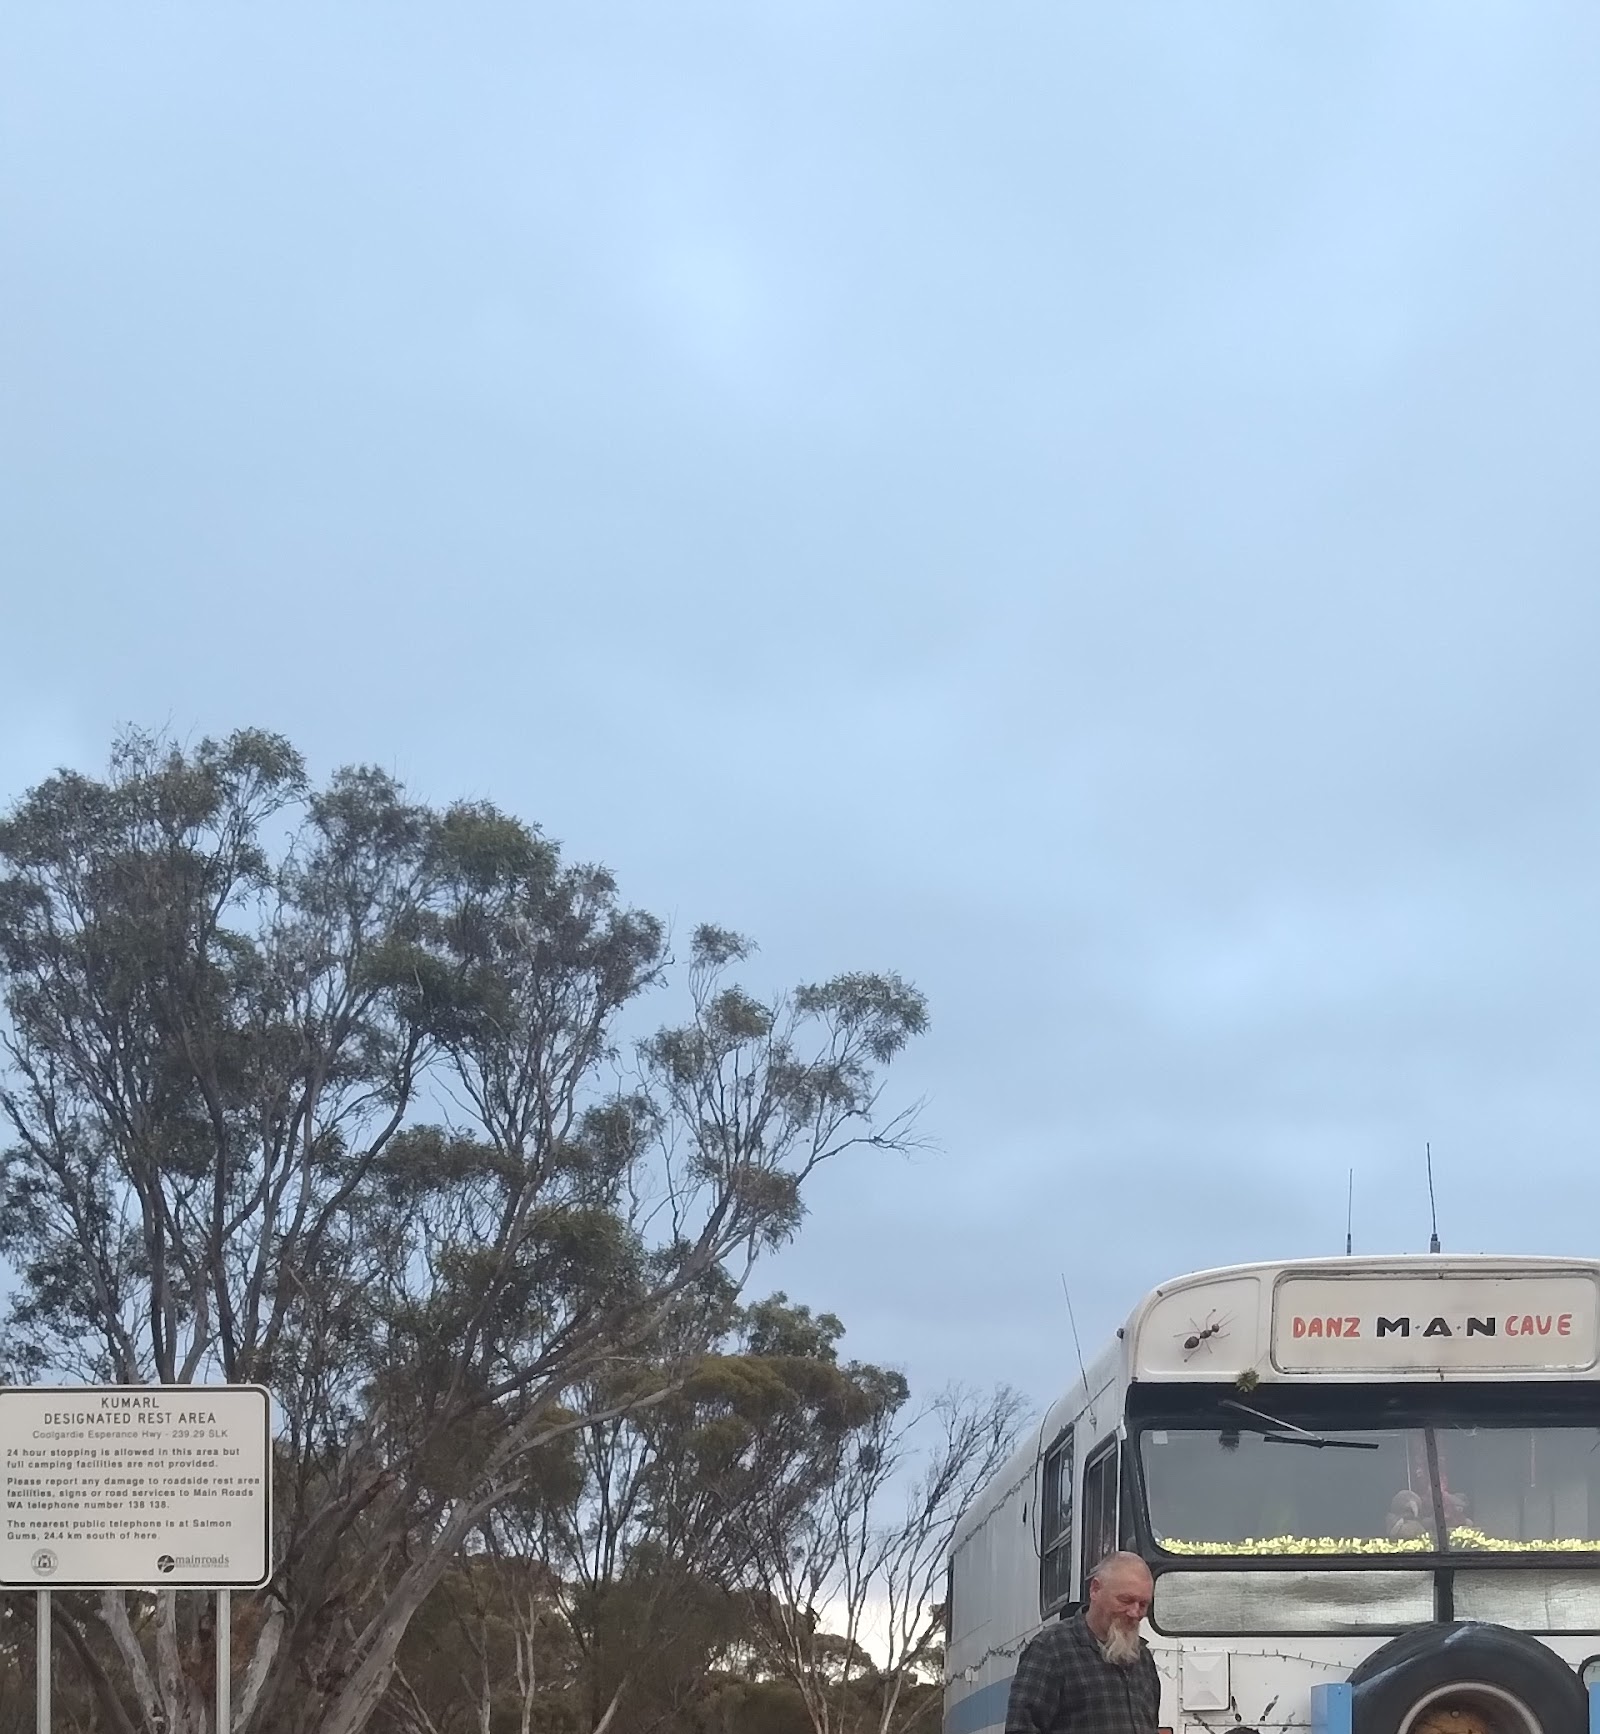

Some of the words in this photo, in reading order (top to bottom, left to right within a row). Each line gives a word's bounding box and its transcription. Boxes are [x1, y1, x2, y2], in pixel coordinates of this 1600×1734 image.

[1293, 1317, 1361, 1338] DANZ
[1505, 1314, 1573, 1336] CAVE
[101, 1397, 160, 1408] KUMARL
[44, 1413, 130, 1424] DESIGNATED
[138, 1412, 172, 1424] REST
[178, 1412, 216, 1424] AREA
[32, 1430, 84, 1440] Coolgardie
[88, 1430, 138, 1440] Esperance
[142, 1430, 162, 1440] Hwy
[209, 1429, 228, 1438] SLK
[51, 1448, 96, 1458] stopping
[101, 1448, 110, 1456] is
[114, 1448, 154, 1456] allowed
[158, 1448, 168, 1456] in
[28, 1460, 72, 1470] camping
[77, 1460, 123, 1468] facilities
[147, 1460, 164, 1468] not
[168, 1460, 218, 1469] provided.
[7, 1477, 41, 1485] Please
[46, 1478, 77, 1487] report
[82, 1479, 100, 1487] any
[104, 1477, 144, 1487] damage
[163, 1477, 208, 1485] roadside
[213, 1477, 233, 1485] rest
[7, 1489, 55, 1498] facilities,
[59, 1489, 87, 1499] signs
[105, 1489, 128, 1497] road
[132, 1489, 175, 1497] services
[193, 1488, 217, 1496] Main
[222, 1488, 253, 1496] Roads
[7, 1501, 23, 1509] WA
[27, 1501, 79, 1510] telephone
[84, 1501, 123, 1509] number
[129, 1501, 145, 1509] 138
[150, 1501, 169, 1509] 138.
[7, 1520, 25, 1528] The
[73, 1520, 105, 1530] public
[110, 1520, 161, 1529] telephone
[193, 1519, 231, 1527] Salmon
[7, 1532, 40, 1541] Gums,
[120, 1532, 130, 1540] of
[175, 1554, 229, 1564] mainroads
